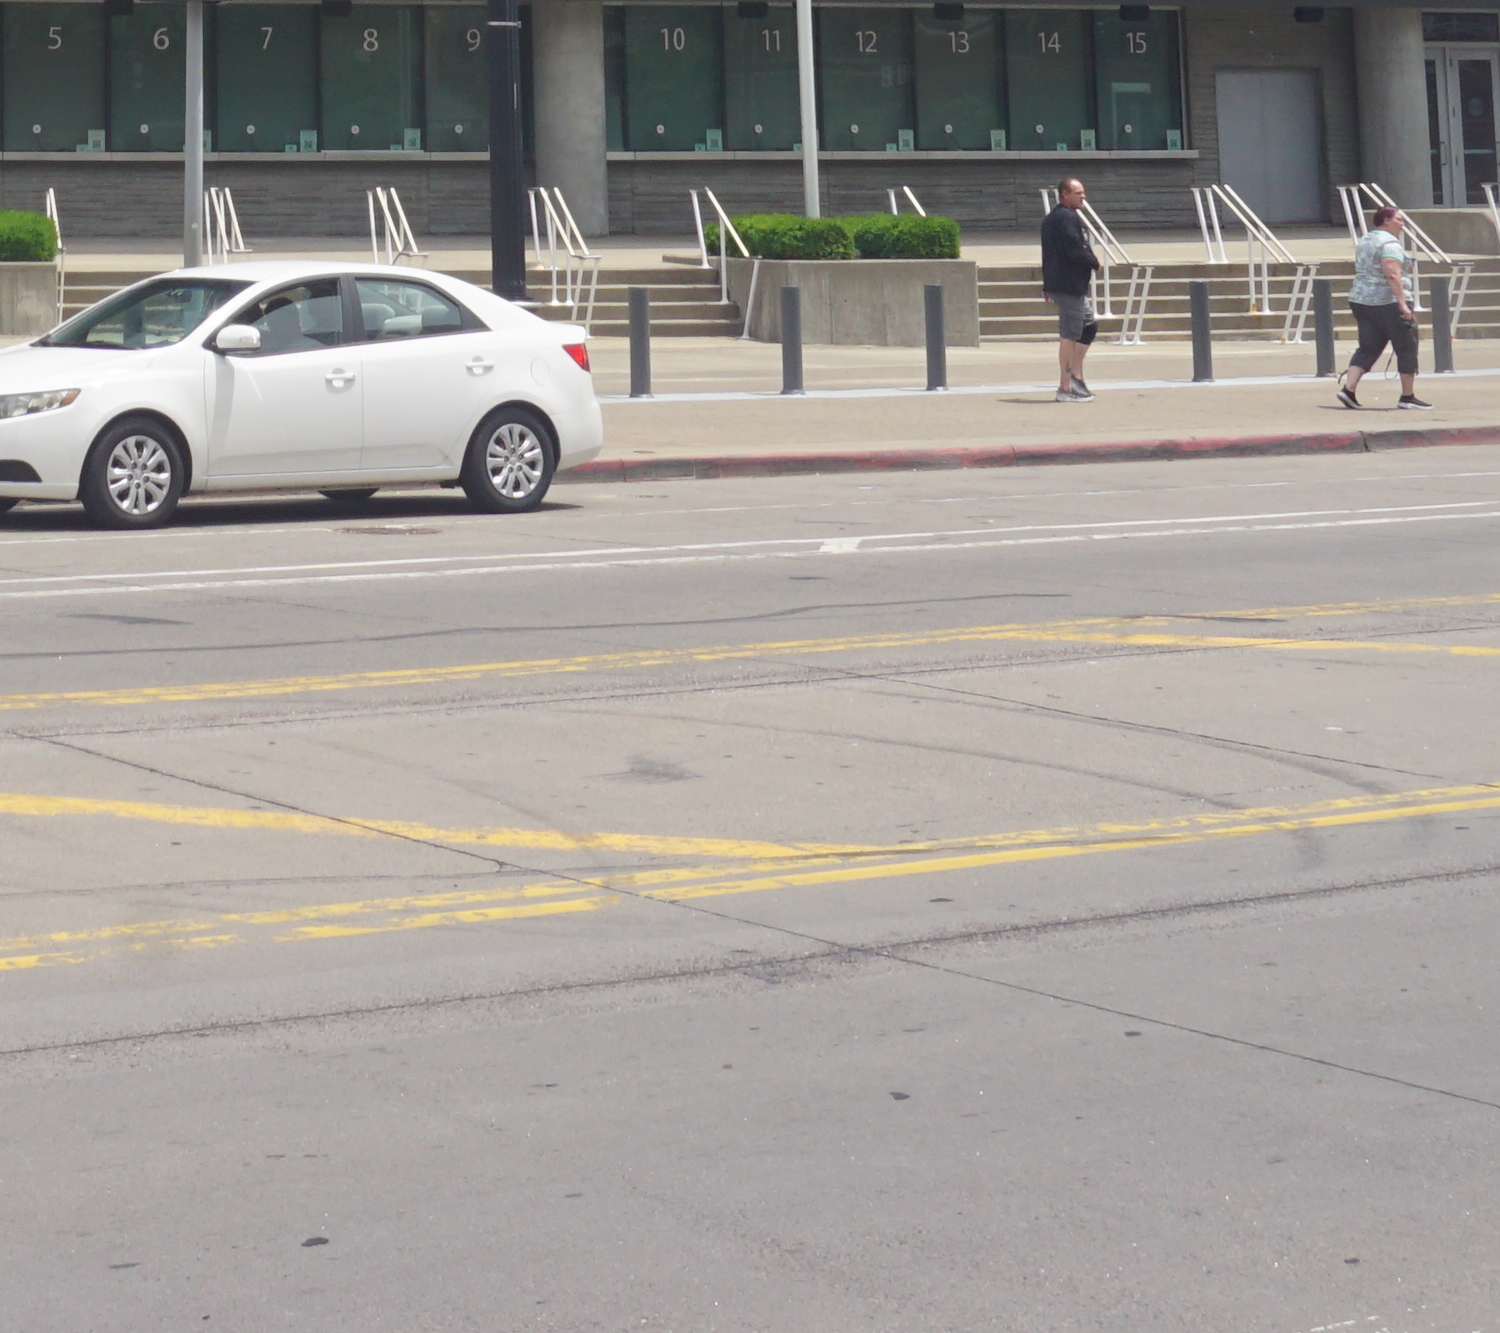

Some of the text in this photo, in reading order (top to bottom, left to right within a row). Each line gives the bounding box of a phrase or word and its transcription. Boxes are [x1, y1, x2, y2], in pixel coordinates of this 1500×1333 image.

[47, 27, 63, 51] 5
[152, 27, 170, 51] 6
[260, 26, 274, 51] 7
[362, 27, 379, 52] 8
[465, 28, 480, 52] 9
[660, 28, 685, 52] 10
[761, 29, 781, 52] 11
[855, 30, 878, 53] 12
[948, 31, 970, 54] 13
[1038, 31, 1062, 54] 14
[1126, 31, 1148, 54] 15
